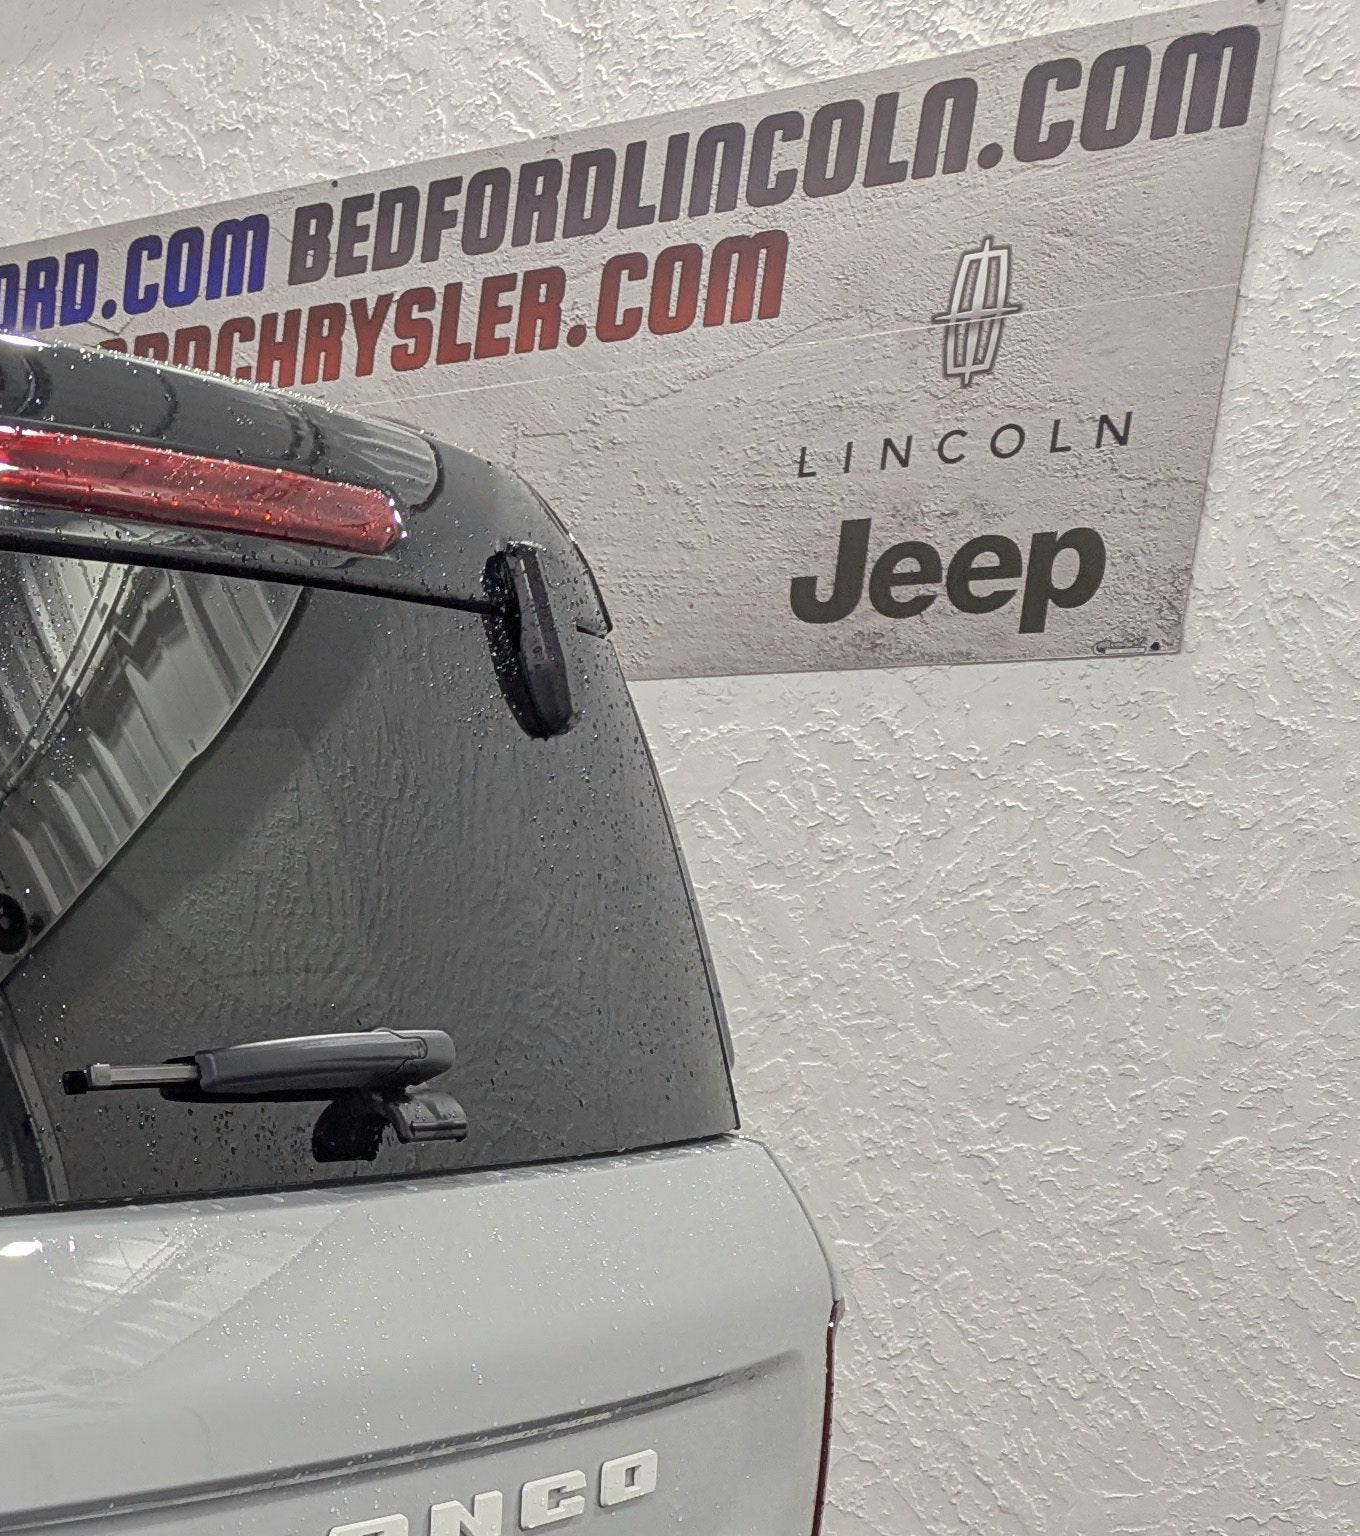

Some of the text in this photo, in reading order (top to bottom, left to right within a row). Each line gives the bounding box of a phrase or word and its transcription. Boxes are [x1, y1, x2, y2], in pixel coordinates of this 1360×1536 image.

[287, 23, 1262, 286] BEDFORDLINCOLN.COM
[797, 411, 1134, 479] LINCOLN
[789, 517, 1107, 635] Jeep
